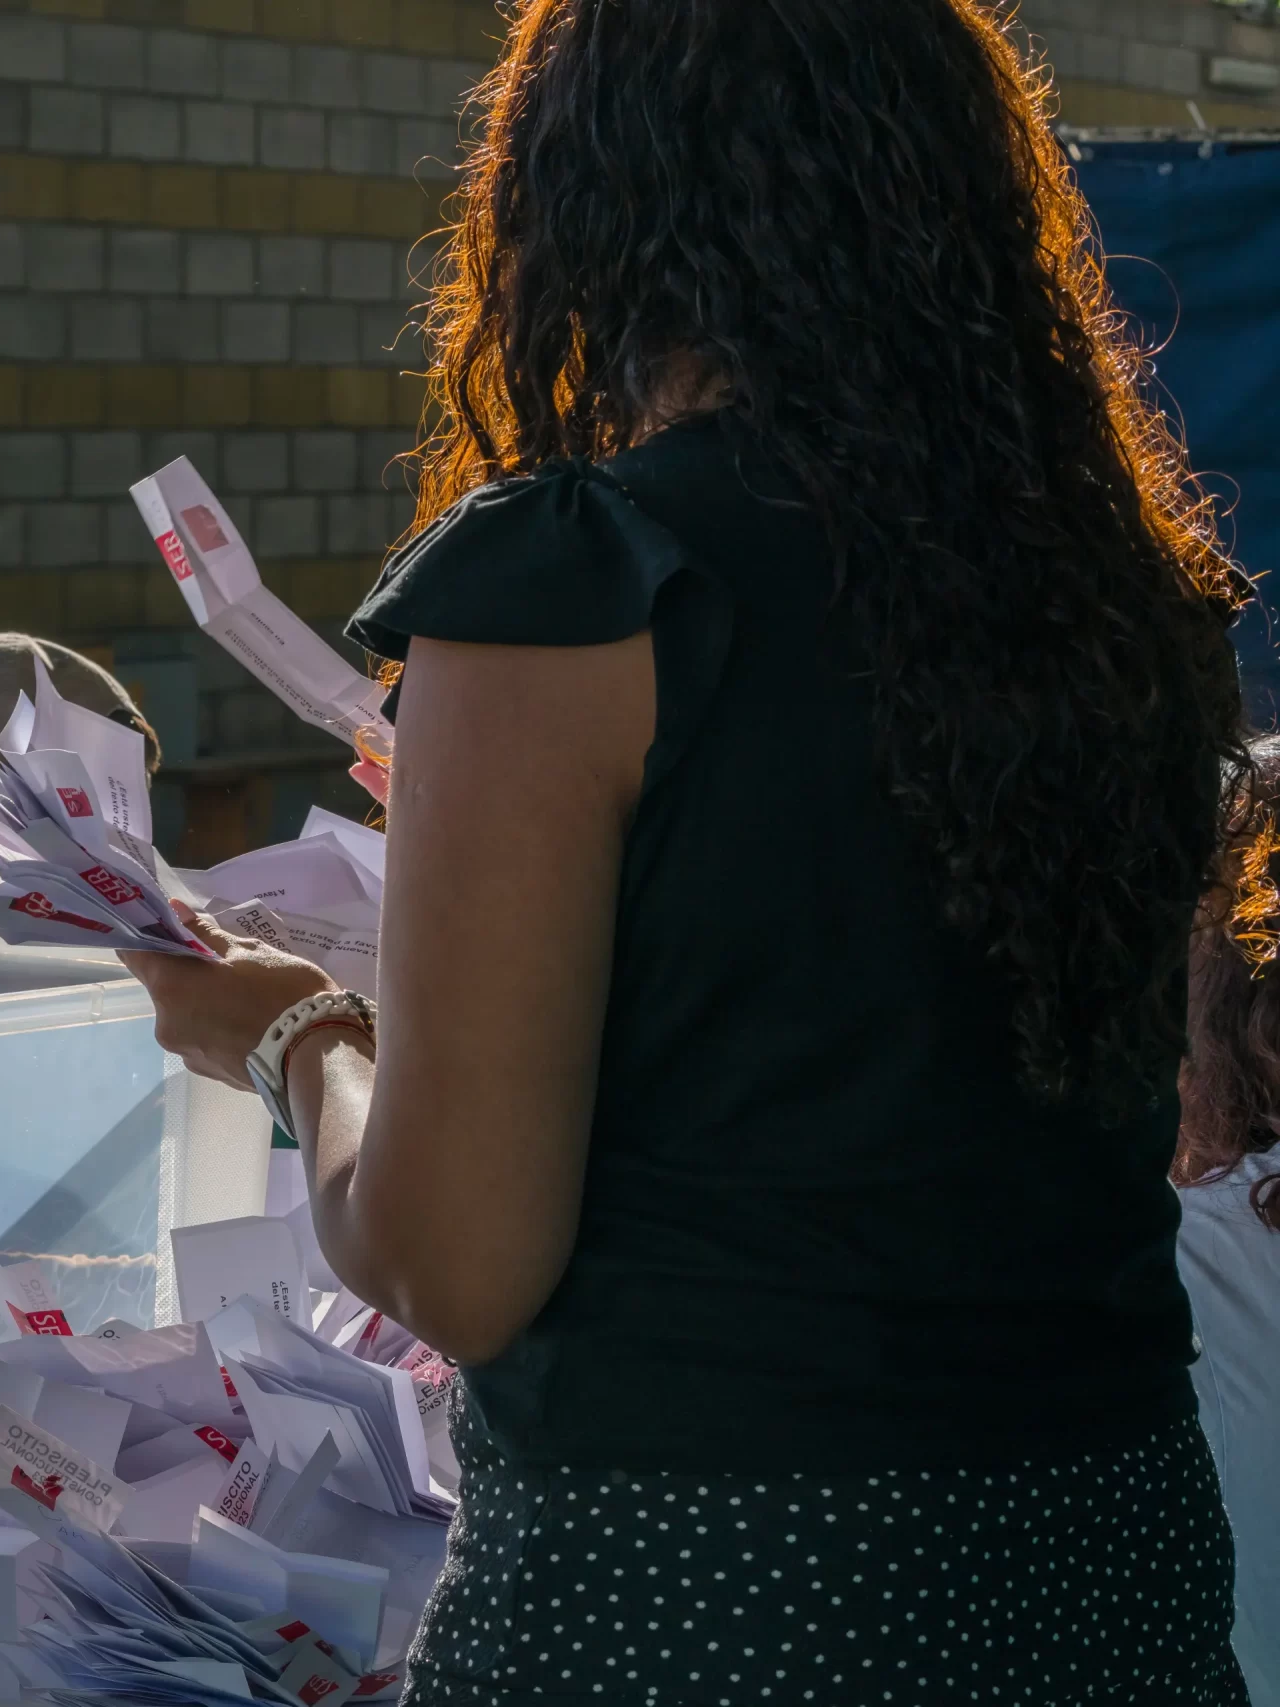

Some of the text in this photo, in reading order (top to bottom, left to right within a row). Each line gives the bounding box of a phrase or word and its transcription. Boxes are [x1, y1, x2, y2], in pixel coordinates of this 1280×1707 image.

[335, 945, 369, 956] Nueva
[272, 1282, 280, 1297] del
[280, 1281, 290, 1311] ¿Está
